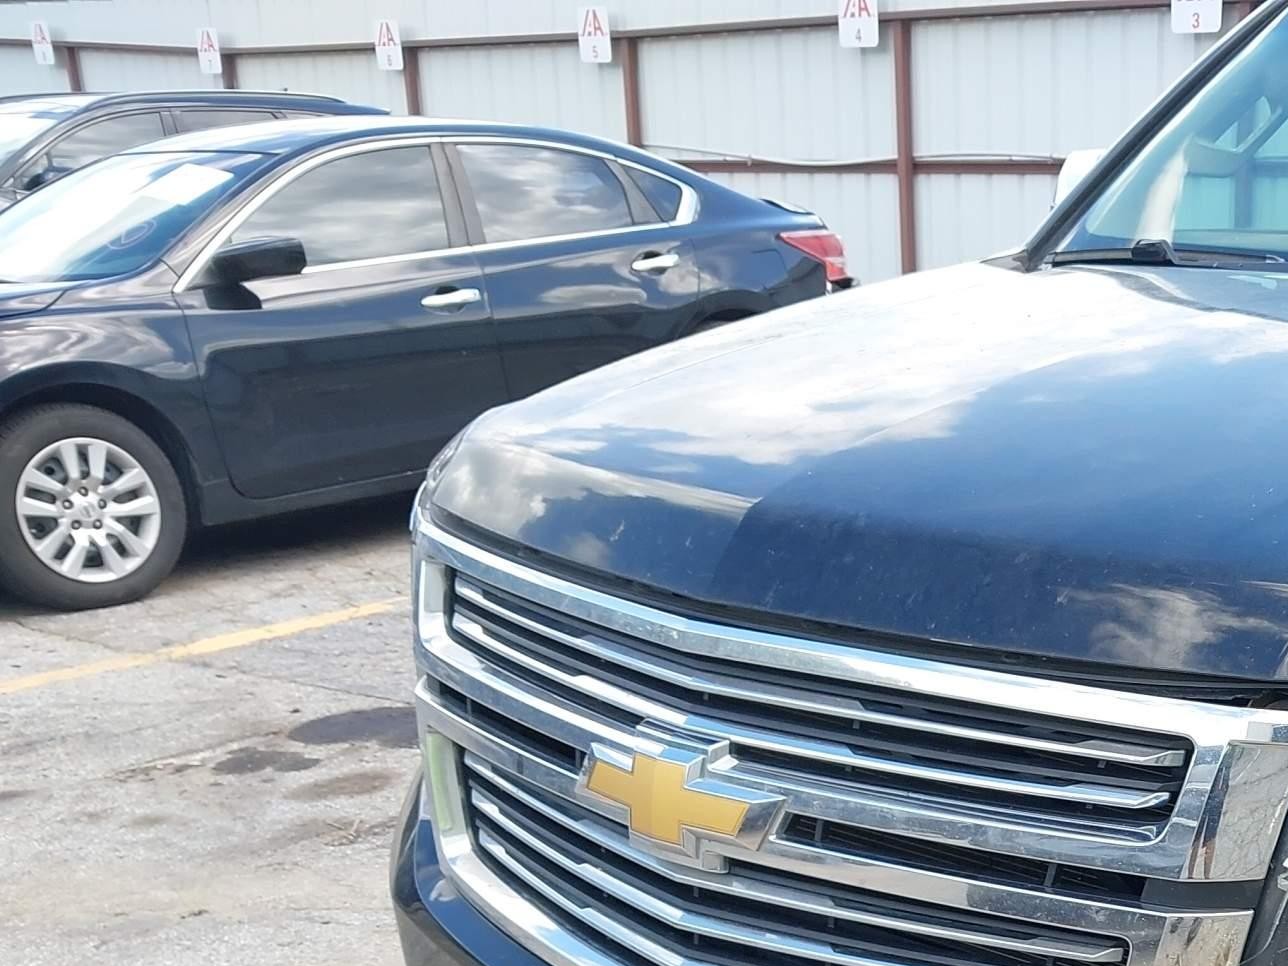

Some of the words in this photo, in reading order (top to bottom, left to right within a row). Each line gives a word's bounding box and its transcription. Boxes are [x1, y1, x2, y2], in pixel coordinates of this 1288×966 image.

[1191, 12, 1200, 29] 3
[855, 28, 862, 42] 4
[592, 45, 599, 59] 5
